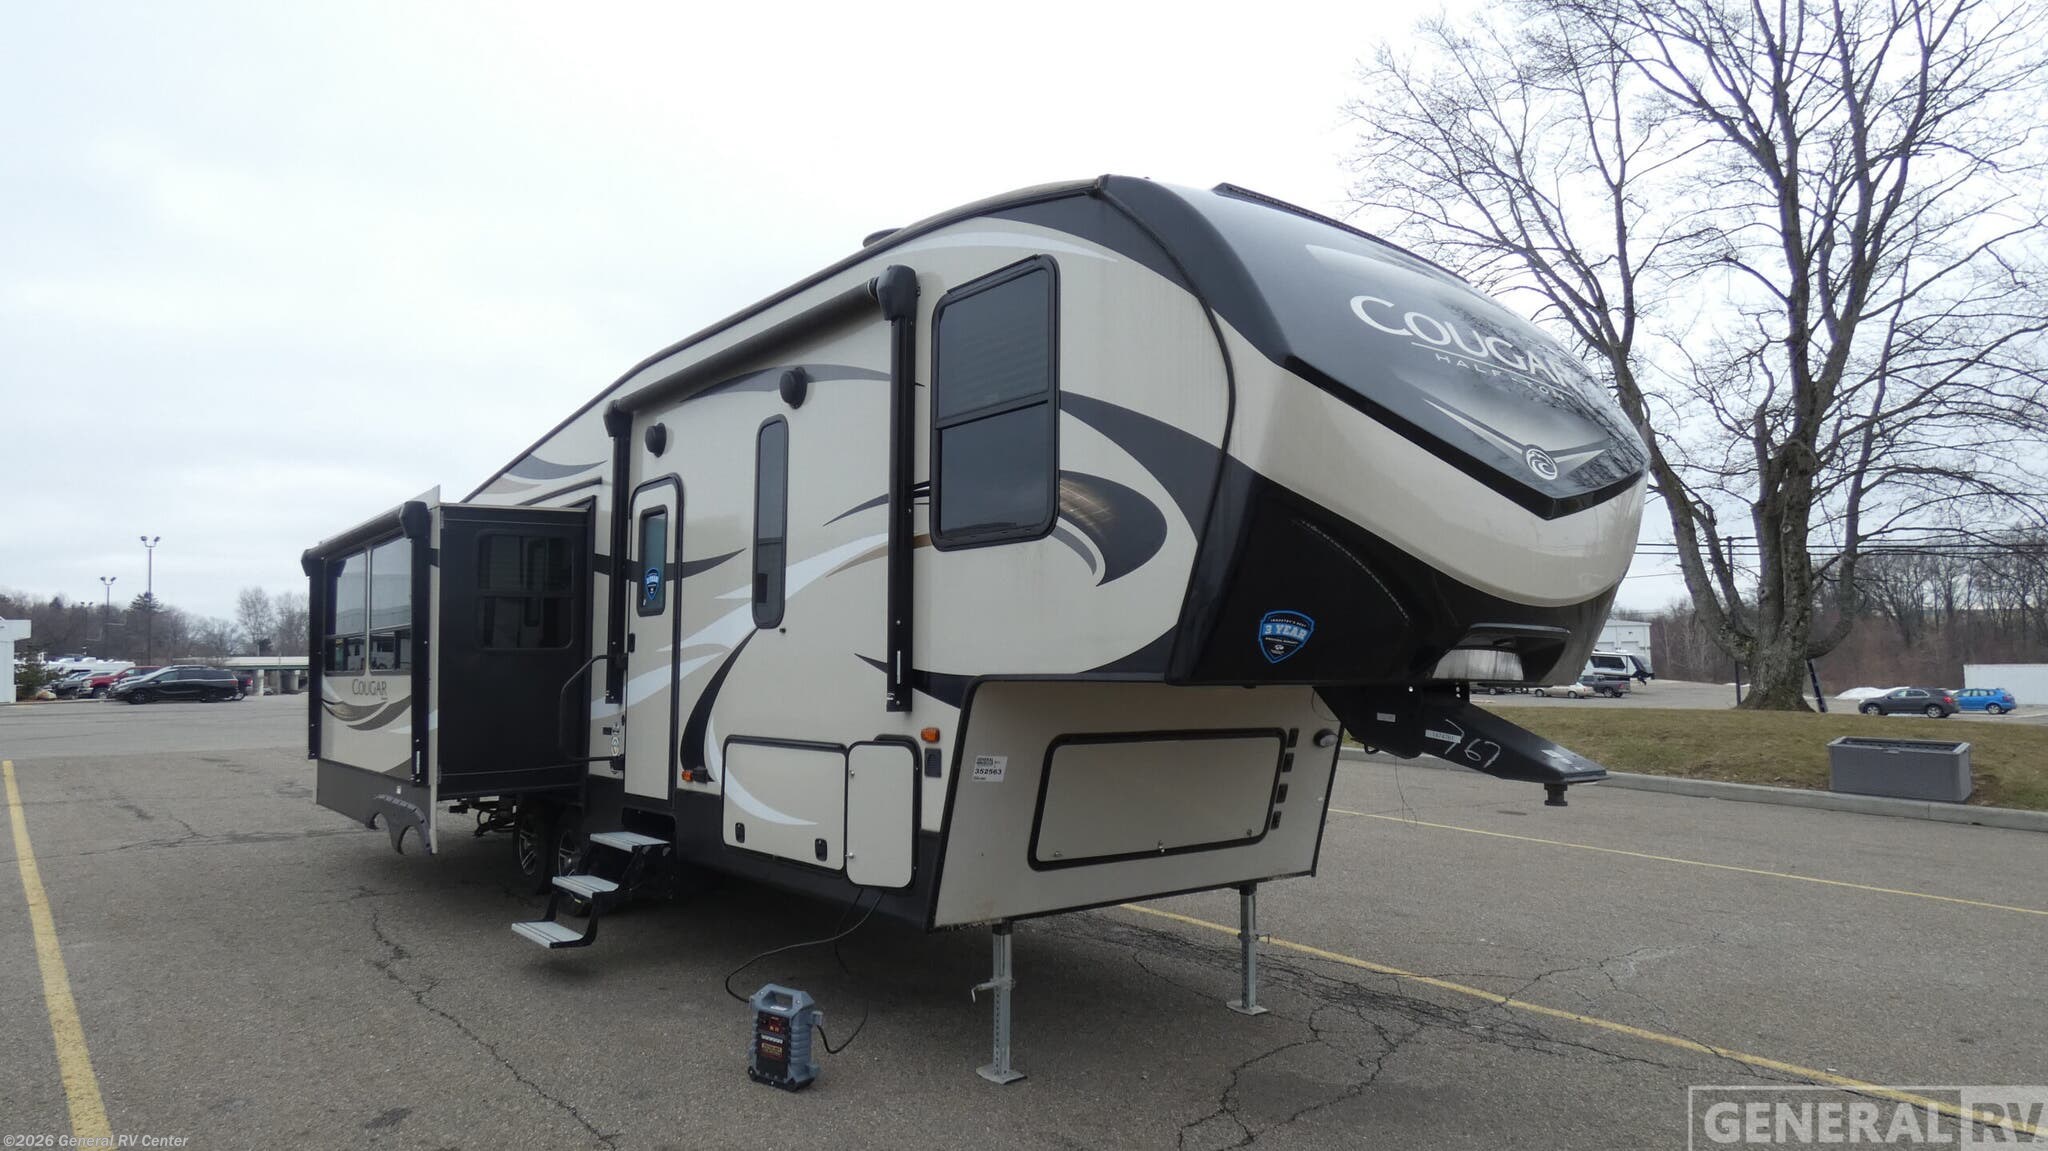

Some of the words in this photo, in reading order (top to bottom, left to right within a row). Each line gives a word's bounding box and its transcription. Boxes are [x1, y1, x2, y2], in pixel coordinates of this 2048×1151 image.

[1350, 295, 1571, 390] COUGAR
[1276, 624, 1308, 641] YEAR
[351, 679, 388, 697] COUGAR
